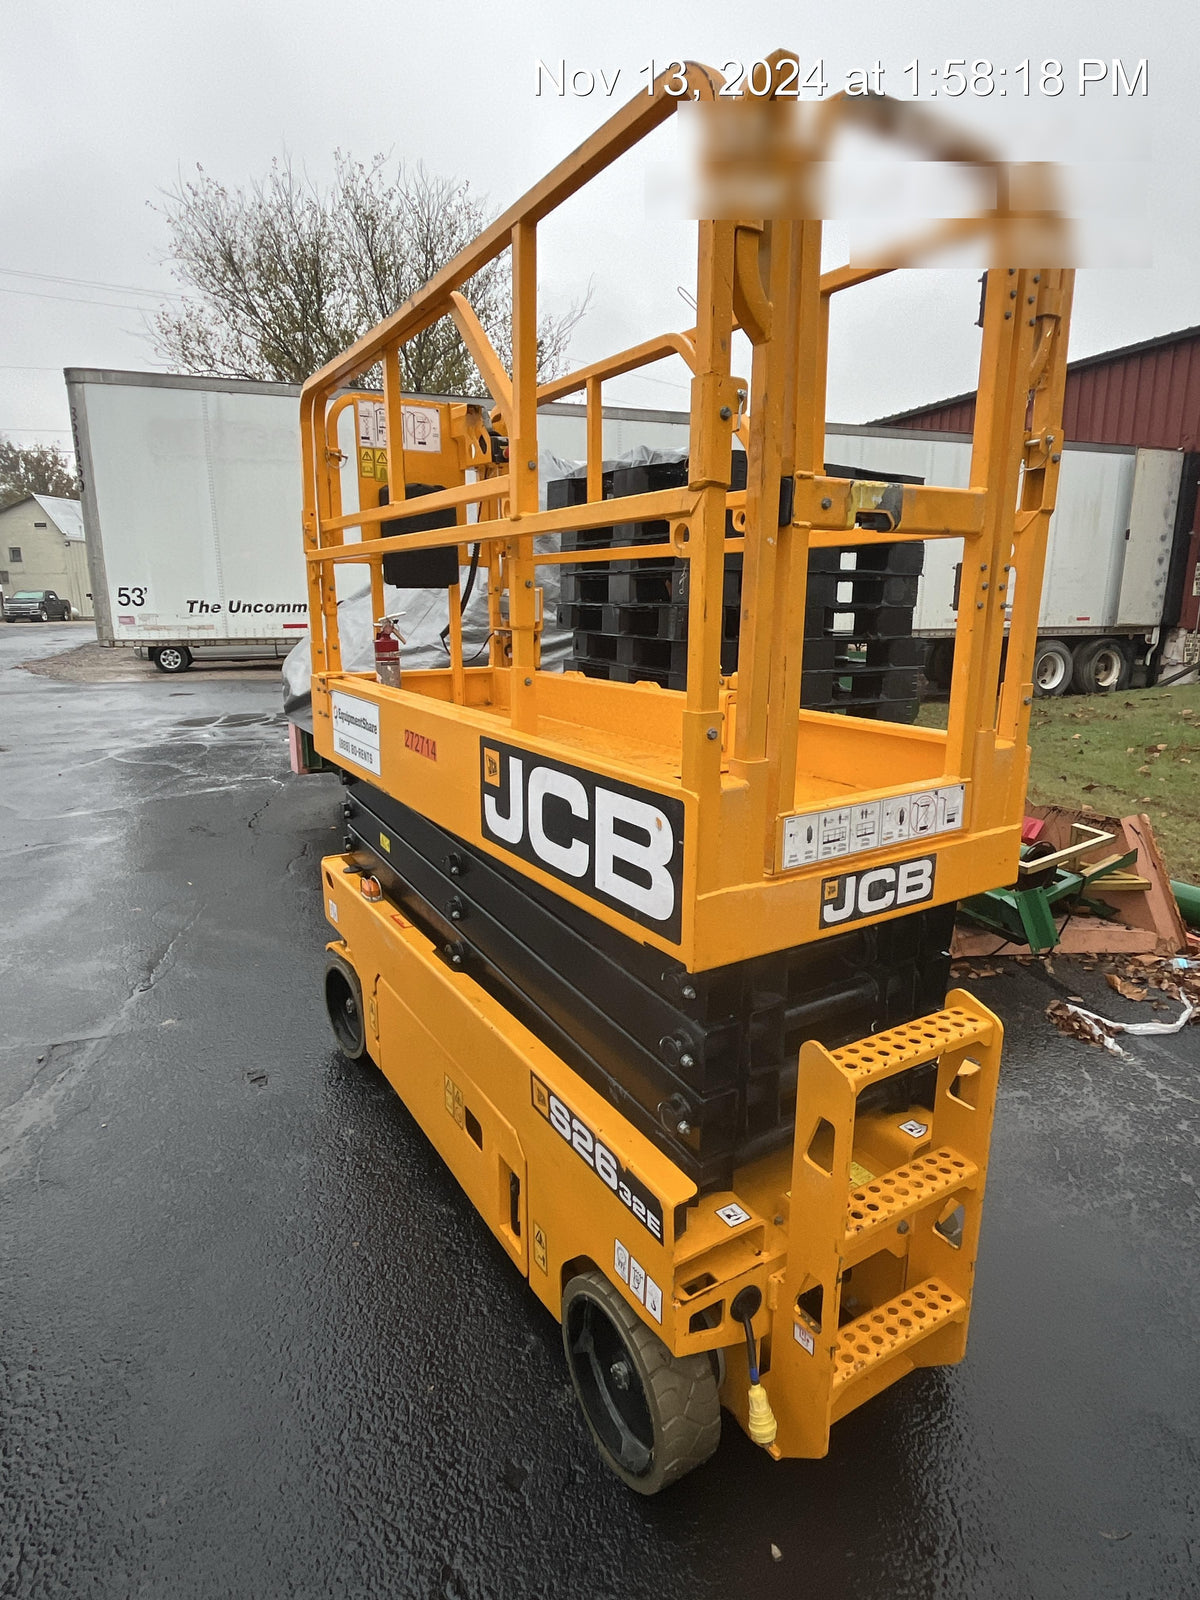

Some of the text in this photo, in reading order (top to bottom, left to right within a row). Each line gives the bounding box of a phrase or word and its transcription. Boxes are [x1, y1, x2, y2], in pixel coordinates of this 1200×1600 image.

[117, 586, 148, 607] 53'
[187, 600, 222, 613] The
[404, 728, 438, 762] 272714
[484, 756, 675, 921] JCB
[823, 859, 934, 923] JCB
